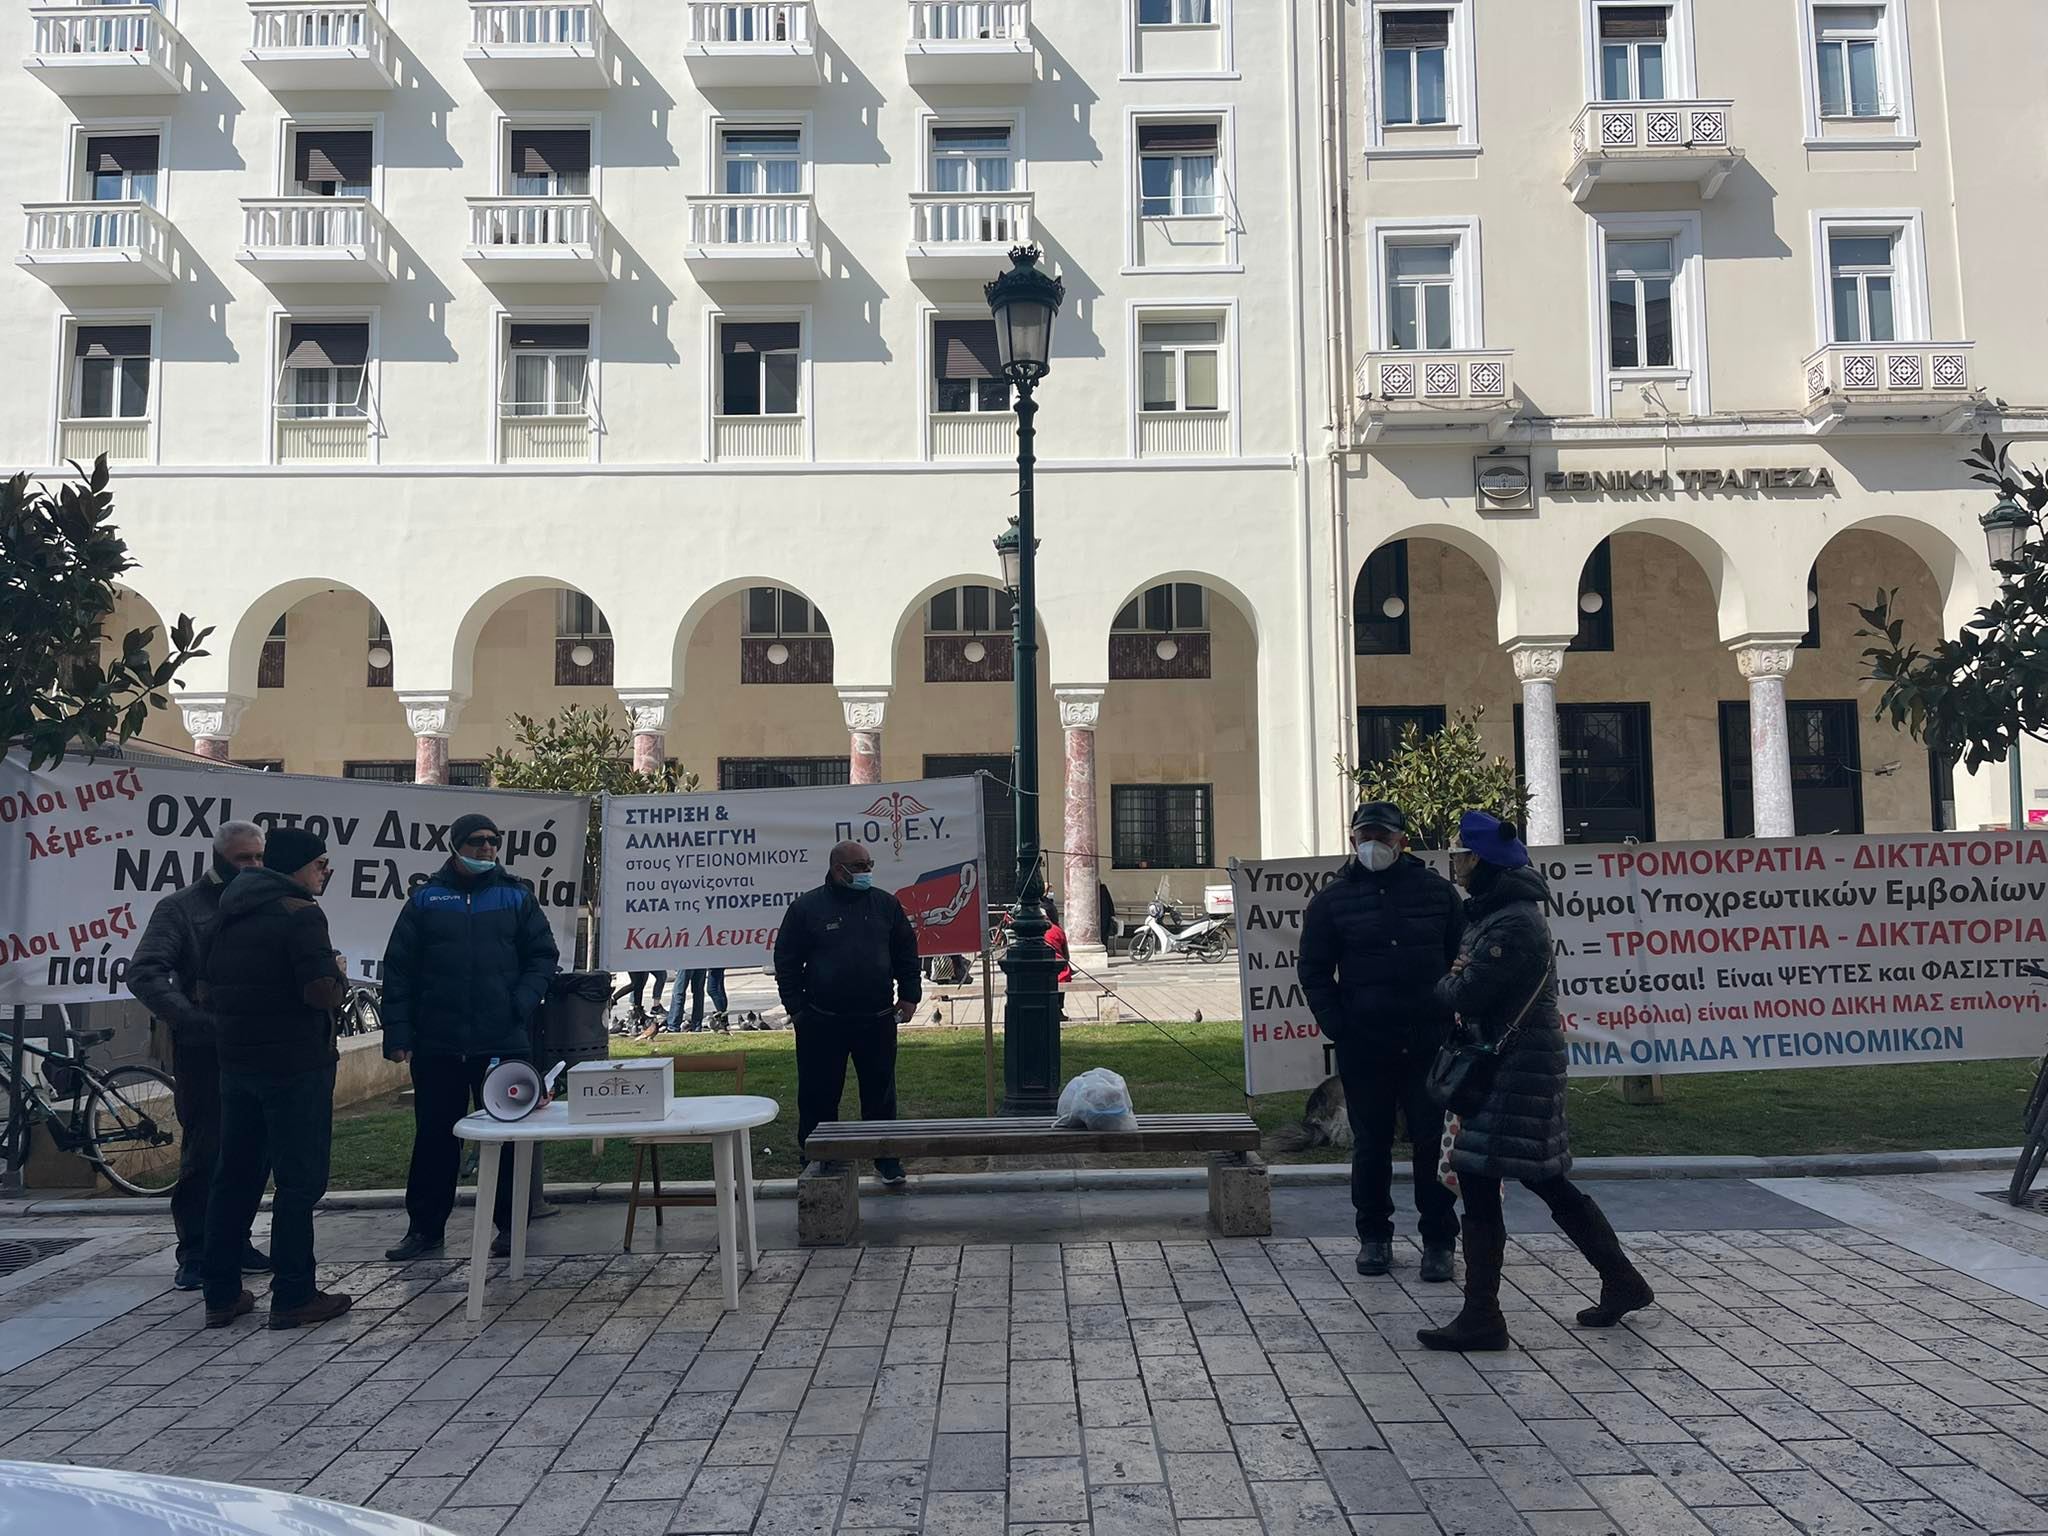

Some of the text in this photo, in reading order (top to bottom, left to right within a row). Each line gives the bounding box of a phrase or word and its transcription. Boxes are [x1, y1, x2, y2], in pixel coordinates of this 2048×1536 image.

[1545, 467, 1835, 491] ΕΘΝΙΚΗ ΤΡΑΠΕΖΑ
[75, 767, 143, 811] μαζί
[147, 794, 232, 838] ΟΧΙ
[373, 810, 557, 865] Διχμό
[625, 805, 729, 824] ΣΤΗΡΙΞΗ &
[25, 826, 134, 860] λέμε...
[625, 828, 756, 849] ΑΛΛΗΛΕΓΓΥΗ
[626, 849, 808, 871] στους ΥΓΕΙΟΝΟΜΙΚΟΥΣ
[1598, 846, 1826, 878] ΤΡΟΜΟΚΡΑΤΙΑ
[1853, 840, 2047, 869] ΔΙΚΤΑΤΟΡΙΑ
[626, 875, 755, 893] που αγωνίζονται
[1641, 880, 1877, 918] Υποχρεωτικών
[1886, 876, 2046, 911] Εμβολίων
[625, 898, 670, 913] ΚΑΤΑ
[674, 900, 700, 913] της
[69, 903, 137, 952] μαζί
[624, 926, 690, 950] Καλή
[1607, 925, 1829, 957] ΤΡΟΜΟΚΡΑΤΙΑ
[1856, 918, 2046, 947] ΔΙΚΤΑΤΟΡΙΑ
[1717, 968, 1772, 988] Είναι
[1778, 963, 1872, 986] ΨΕΥΤΕΣ
[1879, 965, 1915, 982] και
[1597, 1003, 1692, 1030] εμβόλια)
[1698, 1002, 1748, 1021] είναι
[1754, 997, 1825, 1019] ΜΟΝΟ
[1831, 995, 1886, 1015] ΔΙΚΗ
[1893, 993, 1944, 1013] ΜΑΣ
[1950, 989, 2047, 1013] επιλογή.
[1631, 1036, 1738, 1063] ΟΜΑΔΑ
[1743, 1026, 1963, 1058] ΥΓΕΙΟΝΟΜΙΚΩΝ
